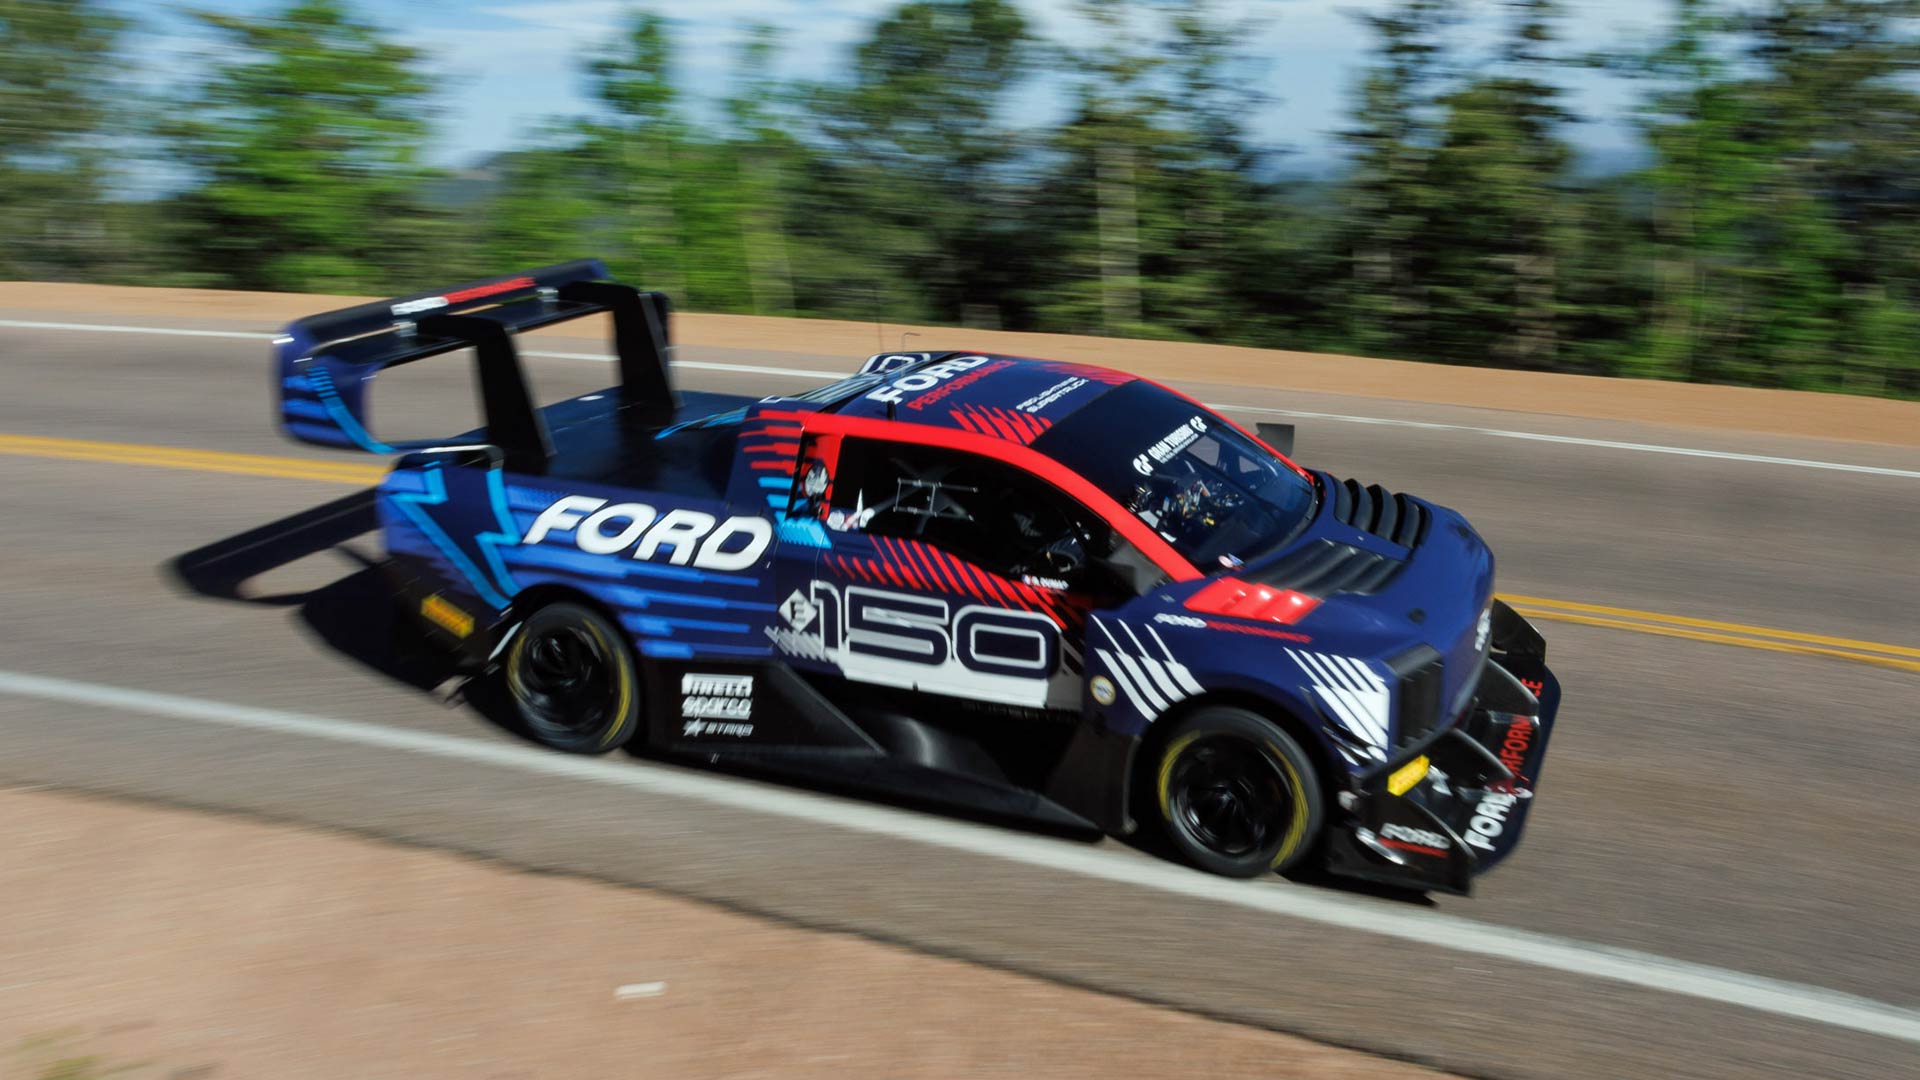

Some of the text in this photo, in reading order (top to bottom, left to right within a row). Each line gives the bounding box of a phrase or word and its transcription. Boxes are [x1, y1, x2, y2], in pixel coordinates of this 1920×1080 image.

[865, 356, 990, 404] FORD
[522, 495, 773, 571] FORD
[810, 579, 1064, 681] 150
[1153, 612, 1208, 629] FORD
